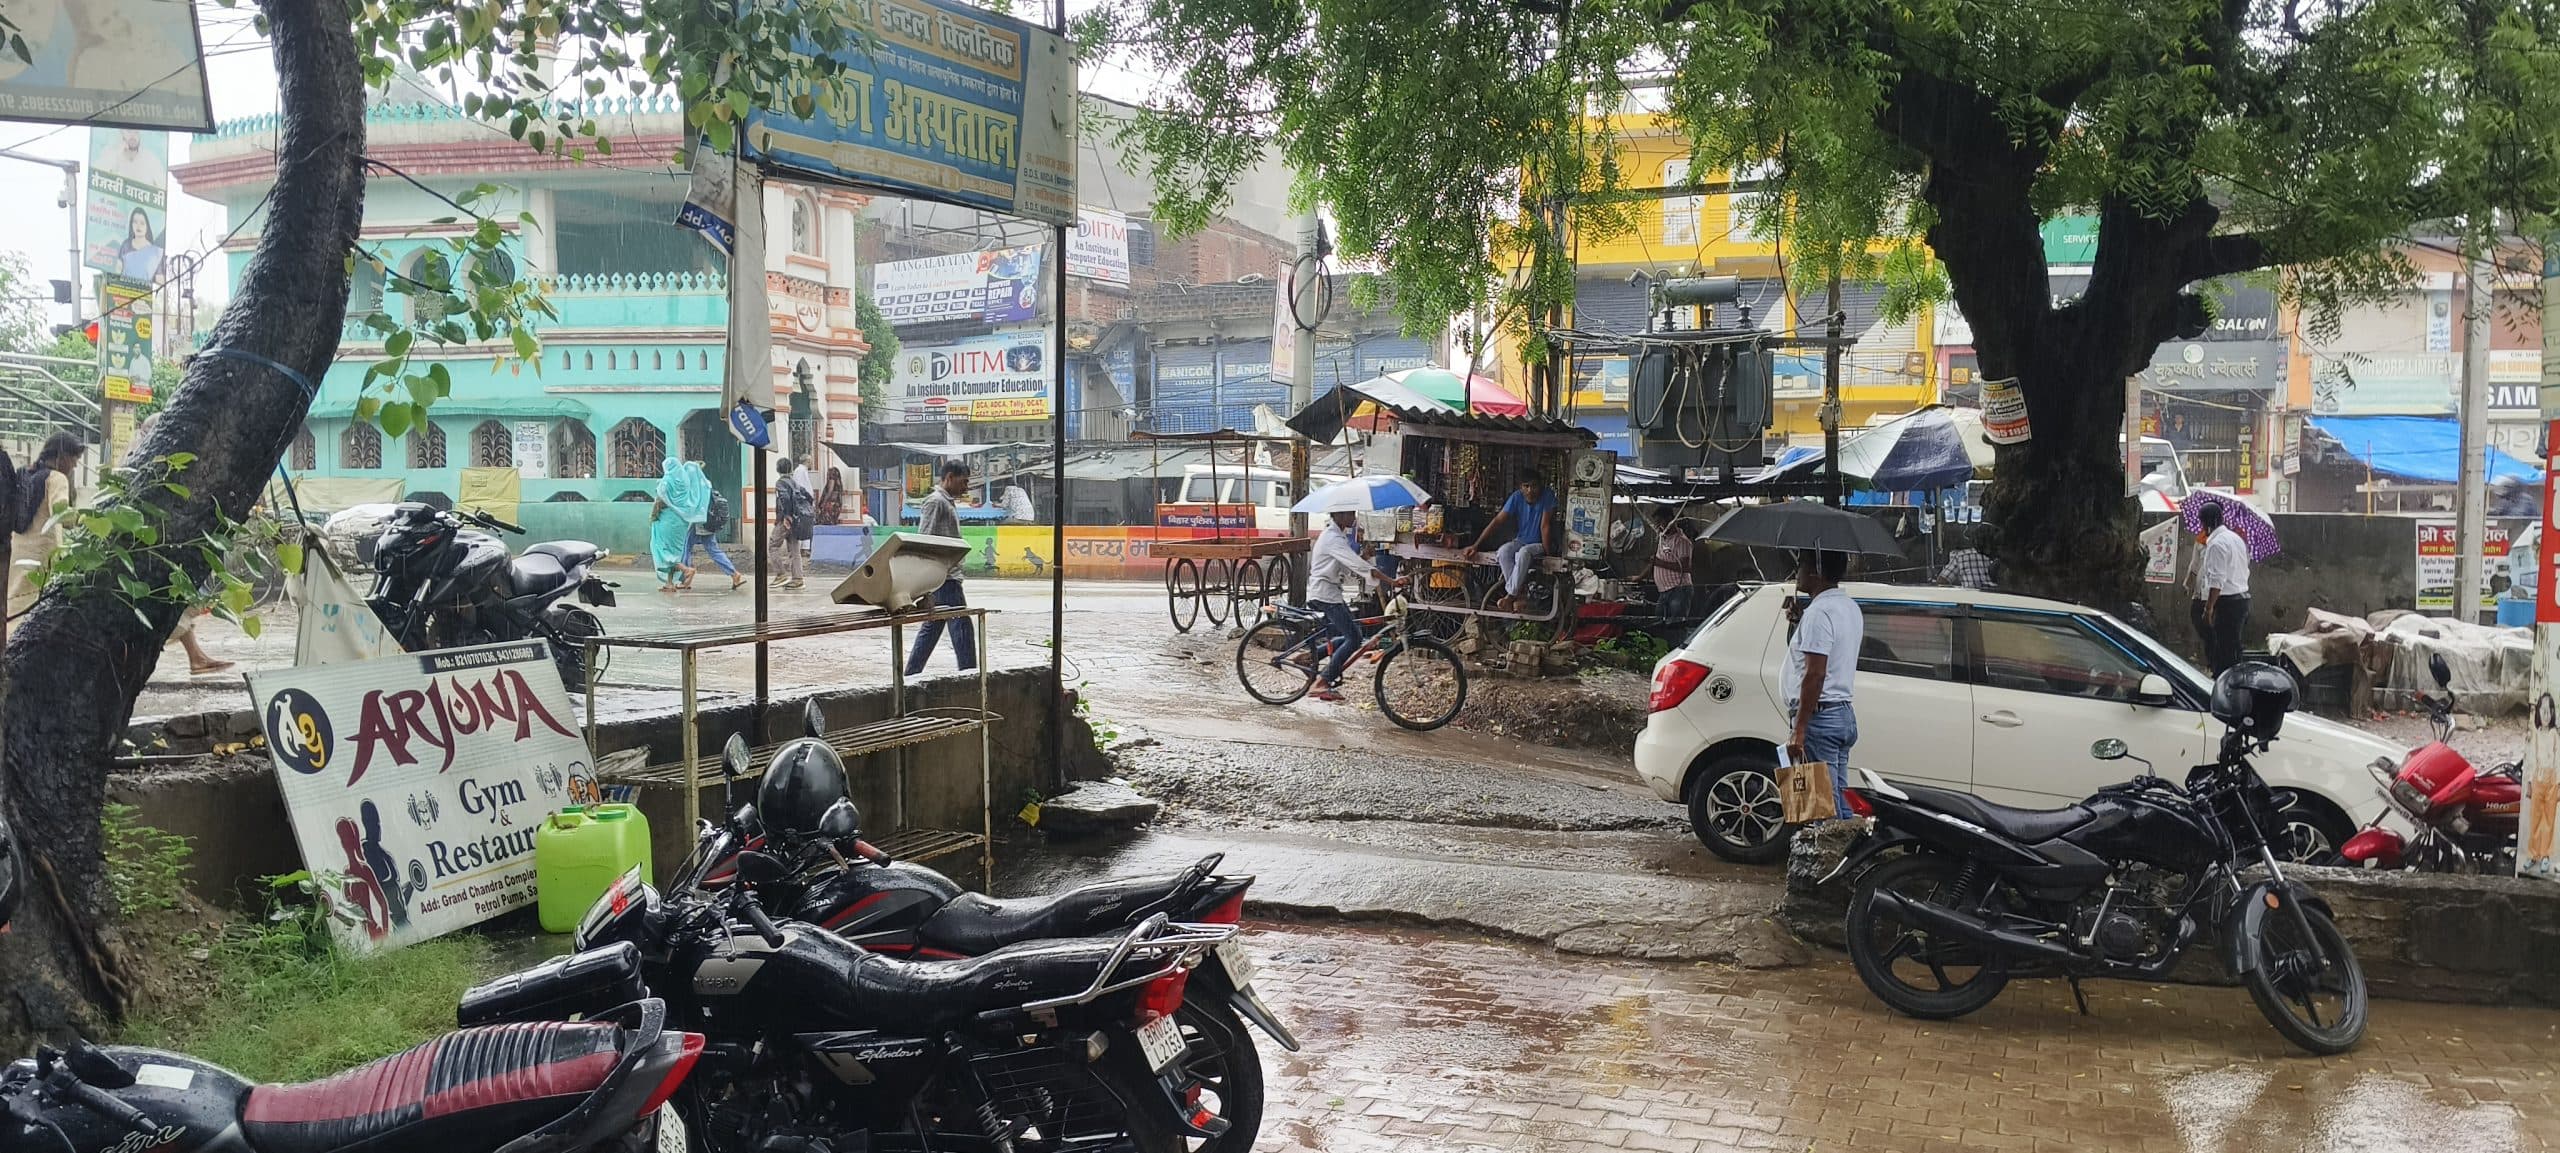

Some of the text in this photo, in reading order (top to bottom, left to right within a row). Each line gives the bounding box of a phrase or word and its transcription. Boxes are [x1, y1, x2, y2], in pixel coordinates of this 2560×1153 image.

[883, 76, 1018, 170] अस्पताल
[91, 170, 166, 207] तेजस्वी यादव जी
[1074, 240, 1085, 250] An
[1085, 241, 1115, 256] Institute
[891, 252, 974, 273] MANGALAYATAN
[1097, 255, 1127, 270] Education
[987, 286, 1013, 301] REPAIR
[931, 349, 1005, 382] DIITM
[1169, 362, 1270, 378] ANICOM ANICO
[1378, 356, 1427, 369] ANICOM
[2357, 359, 2405, 376] INCORP
[906, 377, 1043, 398] An Institute Of Computer Education
[2419, 526, 2439, 543] श्री
[1066, 538, 1149, 562] स्वच्छ भ
[345, 667, 579, 788] ARJUNA
[458, 777, 527, 825] Gym
[500, 808, 513, 827] &
[425, 823, 542, 879] Restaur
[420, 897, 441, 915] Add:
[441, 887, 468, 908] Grand
[468, 880, 504, 898] Chandra
[474, 884, 539, 915] Petrol Pump, Sa
